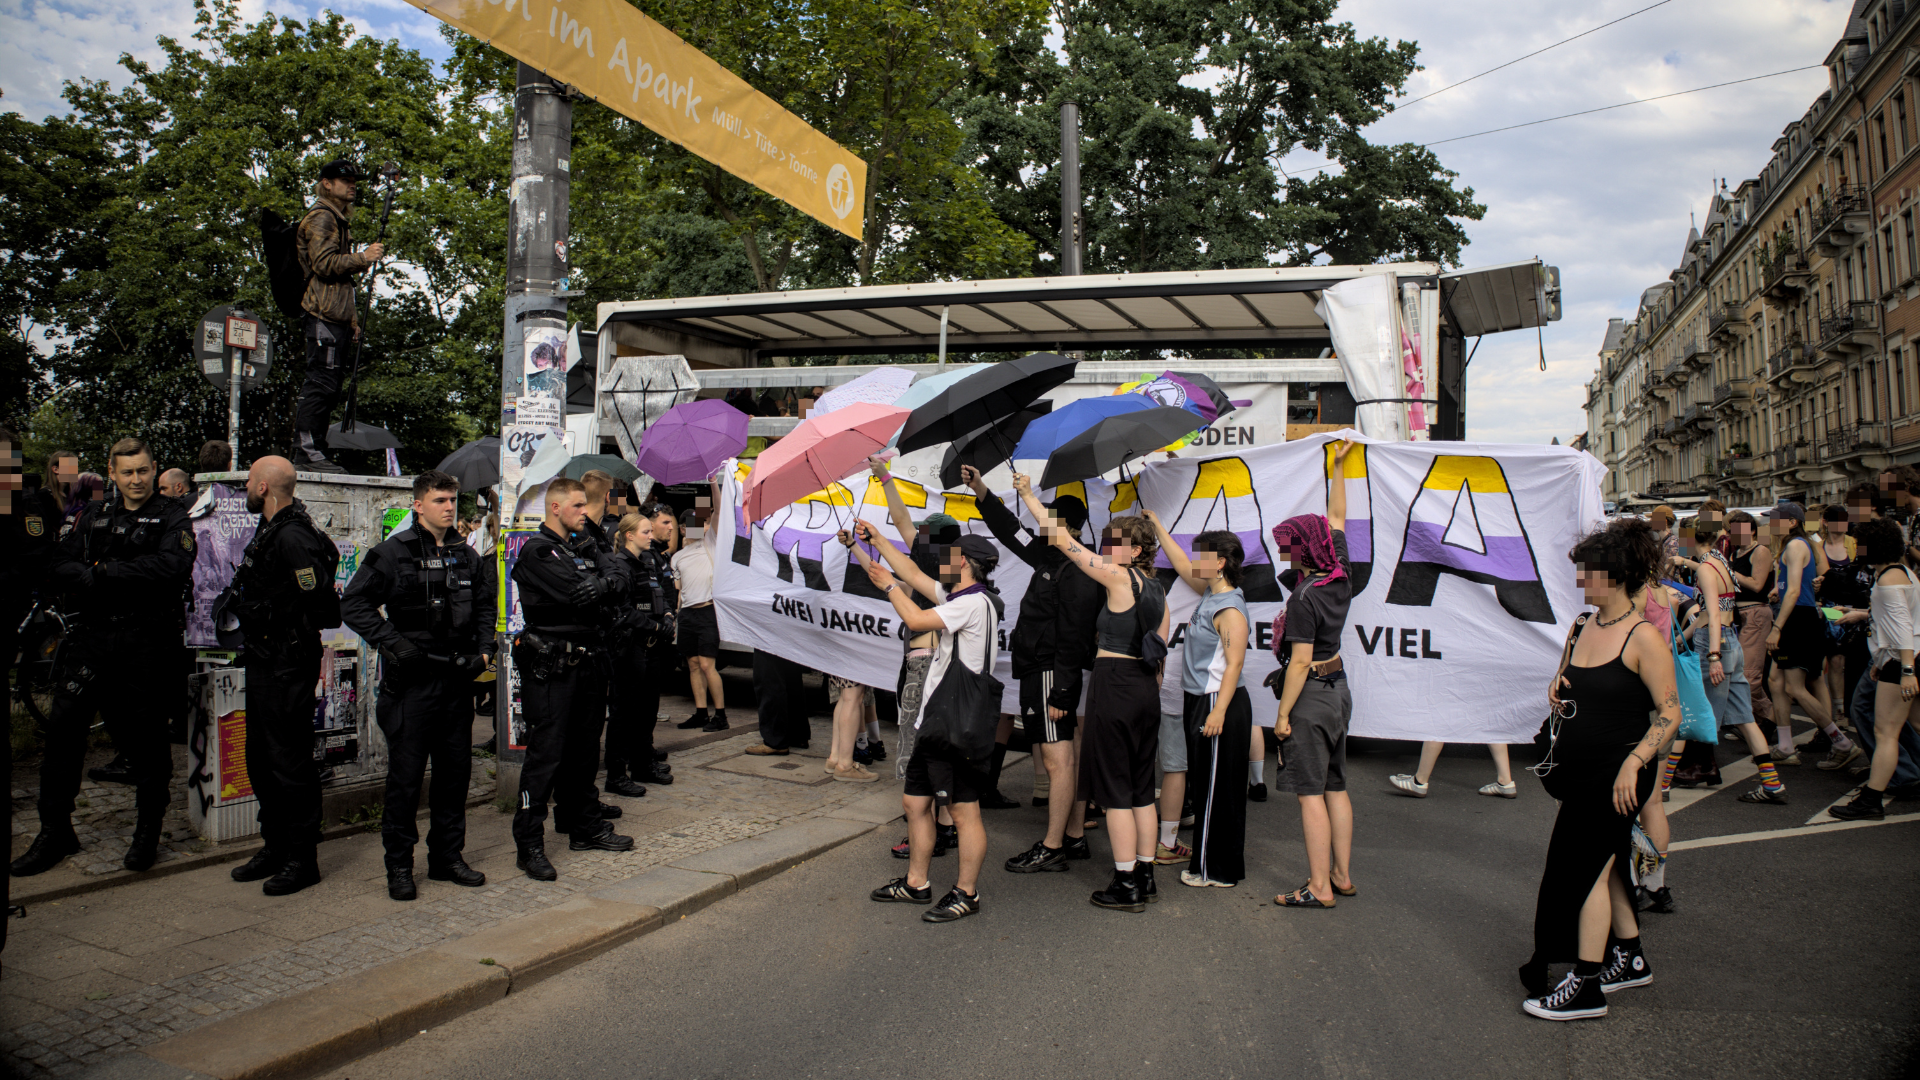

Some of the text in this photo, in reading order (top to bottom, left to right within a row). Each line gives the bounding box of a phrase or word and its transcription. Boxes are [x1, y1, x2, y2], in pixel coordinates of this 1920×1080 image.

[549, 0, 702, 123] im Apark
[712, 106, 742, 137] Müll
[755, 130, 778, 159] Tüte
[789, 153, 818, 184] Tonne
[772, 593, 813, 624] ZWEI
[820, 608, 892, 639] JAHRE
[1354, 624, 1442, 660] VIEL
